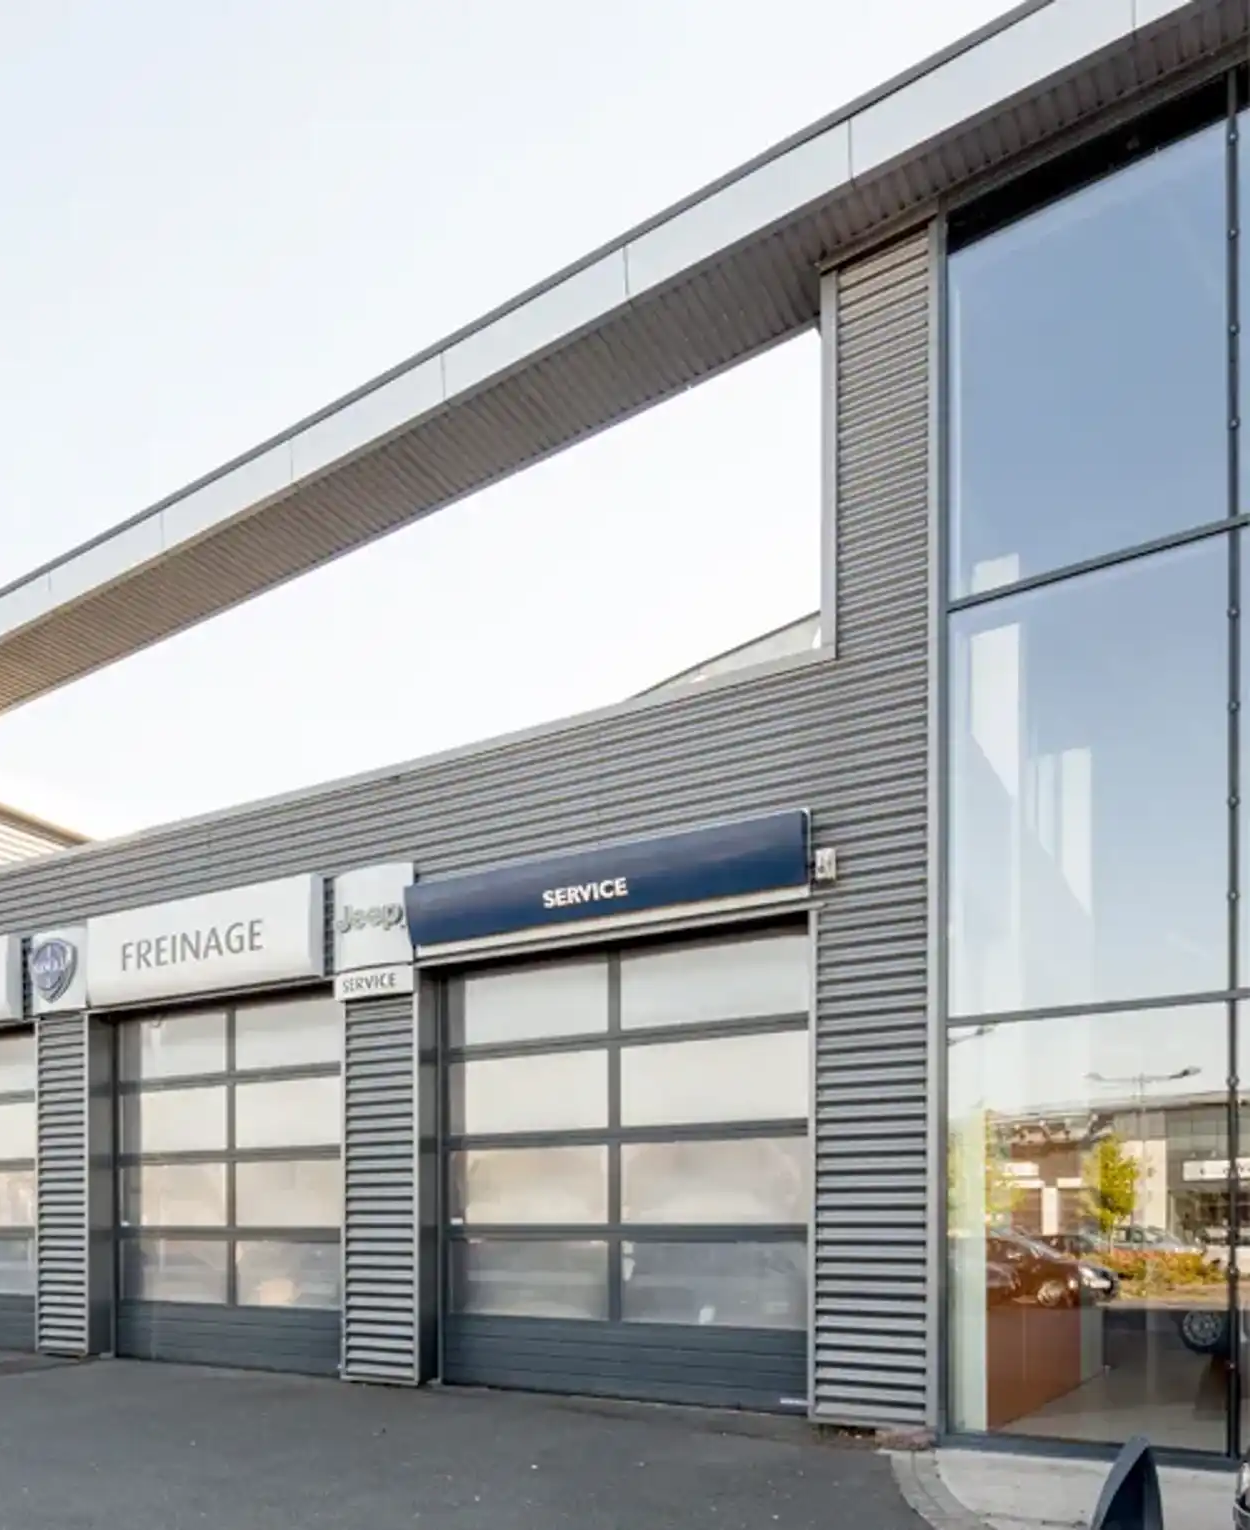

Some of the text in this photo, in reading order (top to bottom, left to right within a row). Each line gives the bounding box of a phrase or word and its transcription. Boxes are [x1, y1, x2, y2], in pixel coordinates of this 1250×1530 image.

[542, 876, 629, 909] SERVICE
[336, 903, 404, 933] Jeep
[121, 919, 264, 971] FREINAGE
[343, 972, 397, 993] SERVICE
